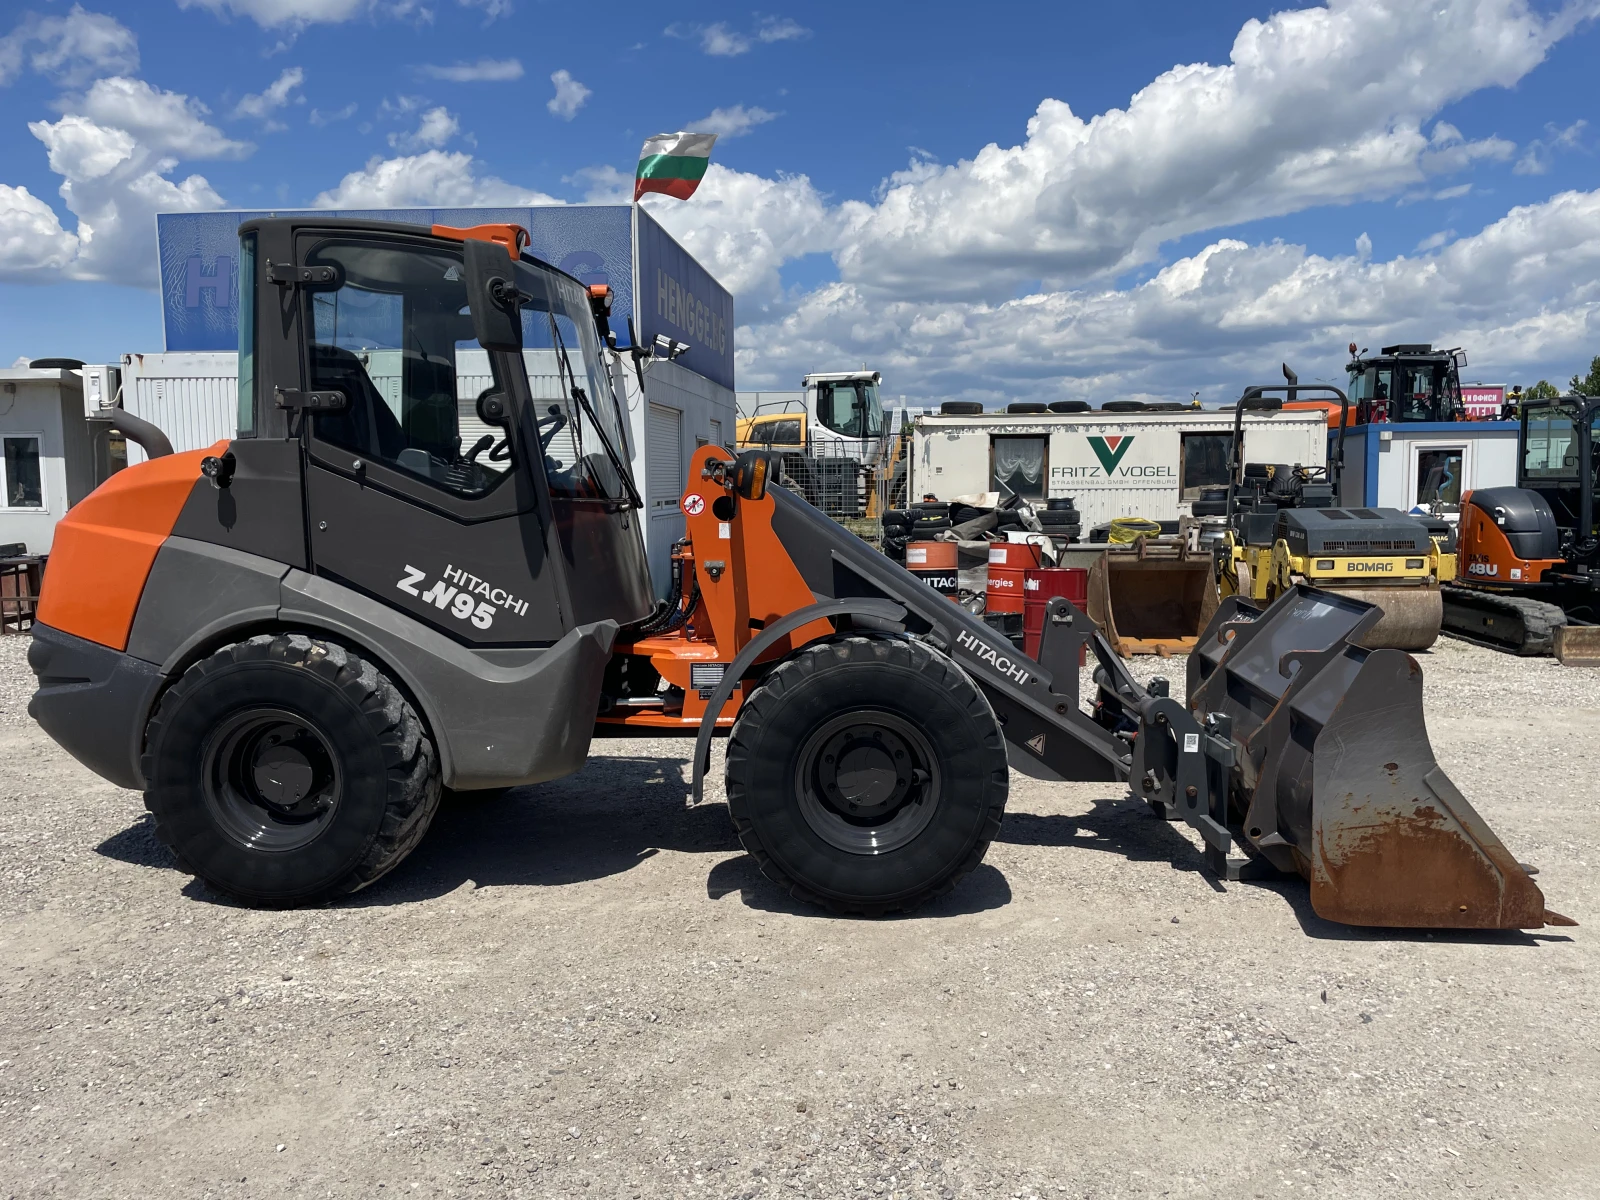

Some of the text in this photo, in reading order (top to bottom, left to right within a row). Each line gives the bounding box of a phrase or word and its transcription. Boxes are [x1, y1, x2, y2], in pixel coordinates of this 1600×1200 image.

[657, 268, 726, 356] HENGGE.BG
[1051, 466, 1176, 478] FRITZ VOGEL
[1347, 562, 1394, 572] BOMAG
[1468, 563, 1498, 576] 48U
[443, 563, 530, 617] HITACHI
[956, 630, 1029, 686] HITACHI
